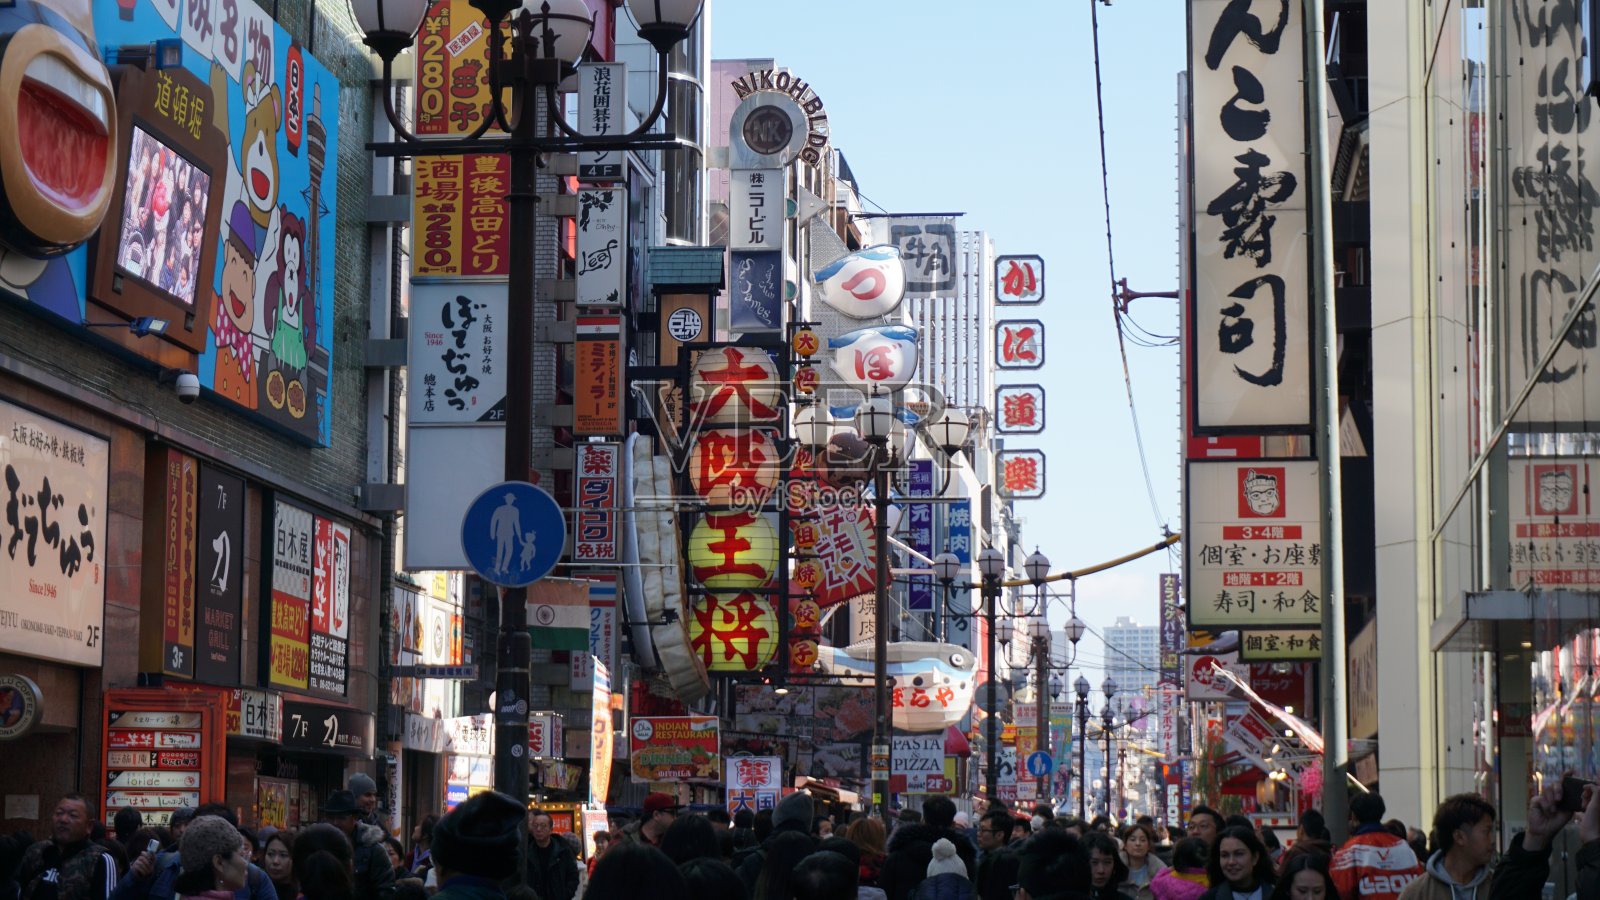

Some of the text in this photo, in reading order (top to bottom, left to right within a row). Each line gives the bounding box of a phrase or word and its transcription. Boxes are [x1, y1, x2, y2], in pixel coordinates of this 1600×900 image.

[449, 25, 480, 54] 居酒屋
[154, 70, 205, 140] 道頓堀
[289, 60, 299, 133] 日本一
[592, 67, 611, 163] 浪花囲碁サン
[731, 69, 827, 167] NIKOH BLDG
[469, 156, 505, 272] 豊後高田どり
[904, 237, 950, 276] 牛角
[425, 332, 444, 340] Since
[427, 339, 443, 347] 1946
[442, 295, 487, 411] ぼてぢゅう
[591, 343, 604, 415] ミティラー
[490, 410, 504, 420] 2F
[584, 445, 611, 475] 薬
[217, 484, 227, 510] 7F
[583, 480, 611, 541] ダイコク
[277, 519, 308, 565] 白木屋
[950, 508, 969, 553] 焼肉
[577, 543, 614, 559] 免税
[1213, 589, 1320, 614] 寿司・和食
[87, 625, 100, 648] 2F
[172, 645, 184, 669] 3F
[291, 715, 309, 739] 7F
[655, 722, 689, 731] INDIAN
[655, 730, 716, 740] RESTAURANT
[893, 739, 942, 751] PASTA
[735, 759, 772, 786] 薬
[894, 759, 941, 771] PIZZA
[927, 778, 944, 789] 2F
